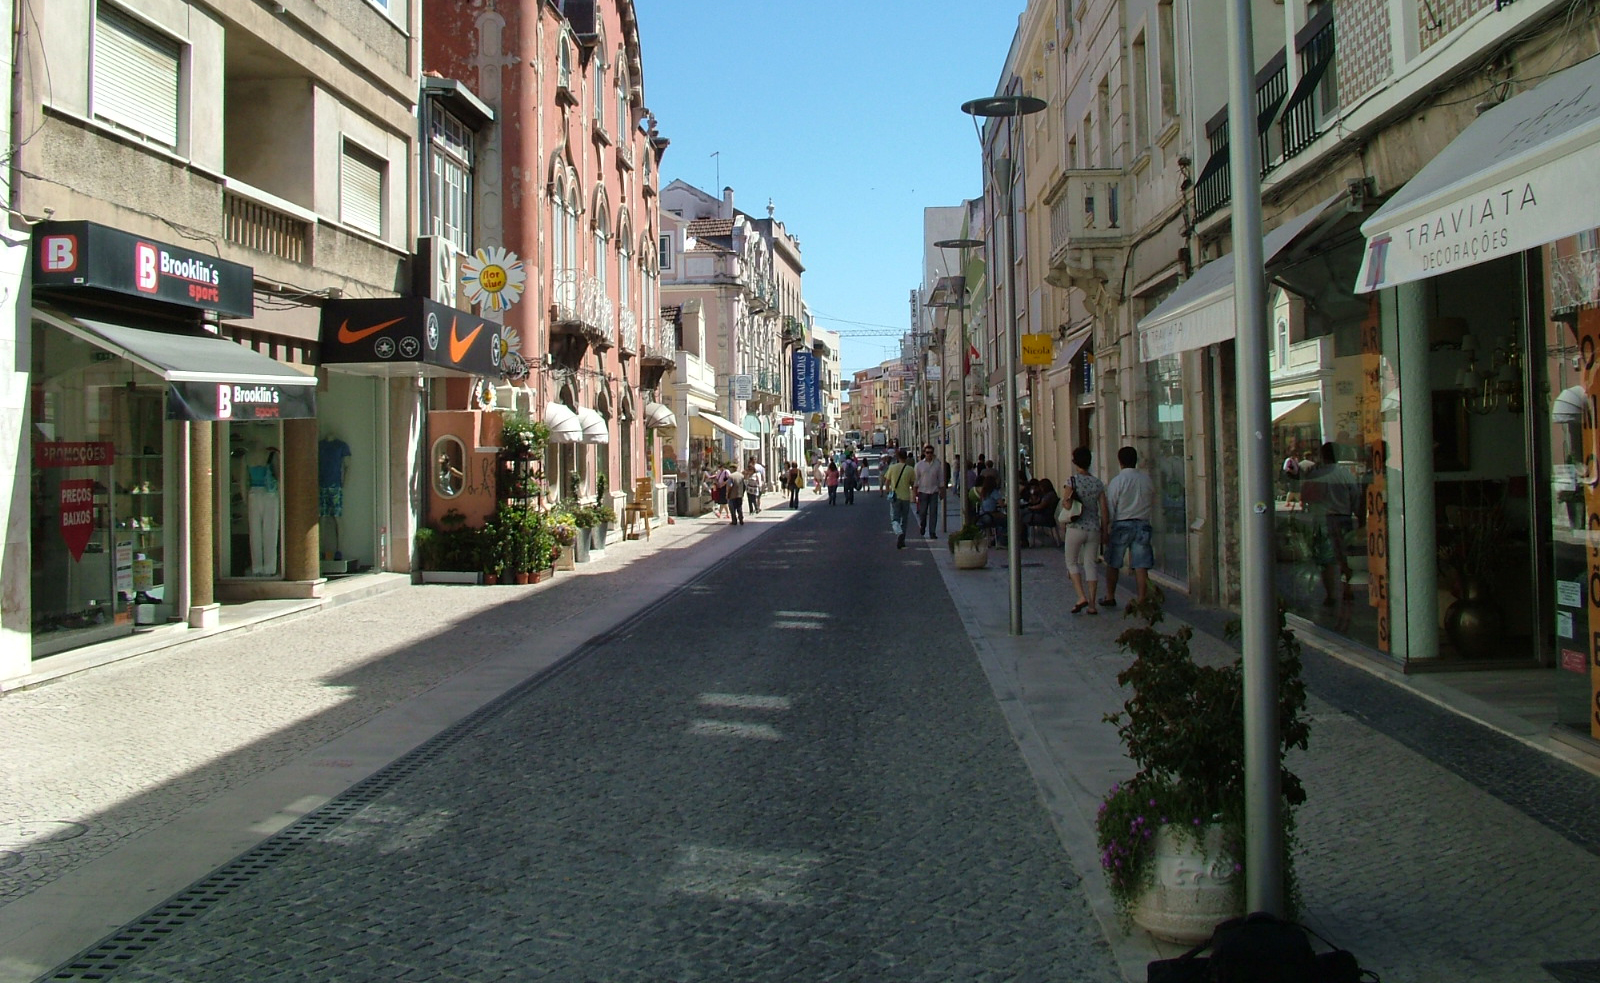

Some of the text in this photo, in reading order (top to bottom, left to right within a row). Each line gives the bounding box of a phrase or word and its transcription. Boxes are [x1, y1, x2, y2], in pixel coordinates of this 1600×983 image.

[1406, 183, 1537, 250] TRAVIATA
[1423, 228, 1509, 271] DECORAÇÕES
[188, 283, 219, 303] sport
[1023, 346, 1050, 355] Nicola
[61, 488, 92, 505] PREÇOS
[62, 510, 91, 527] BAIXOS
